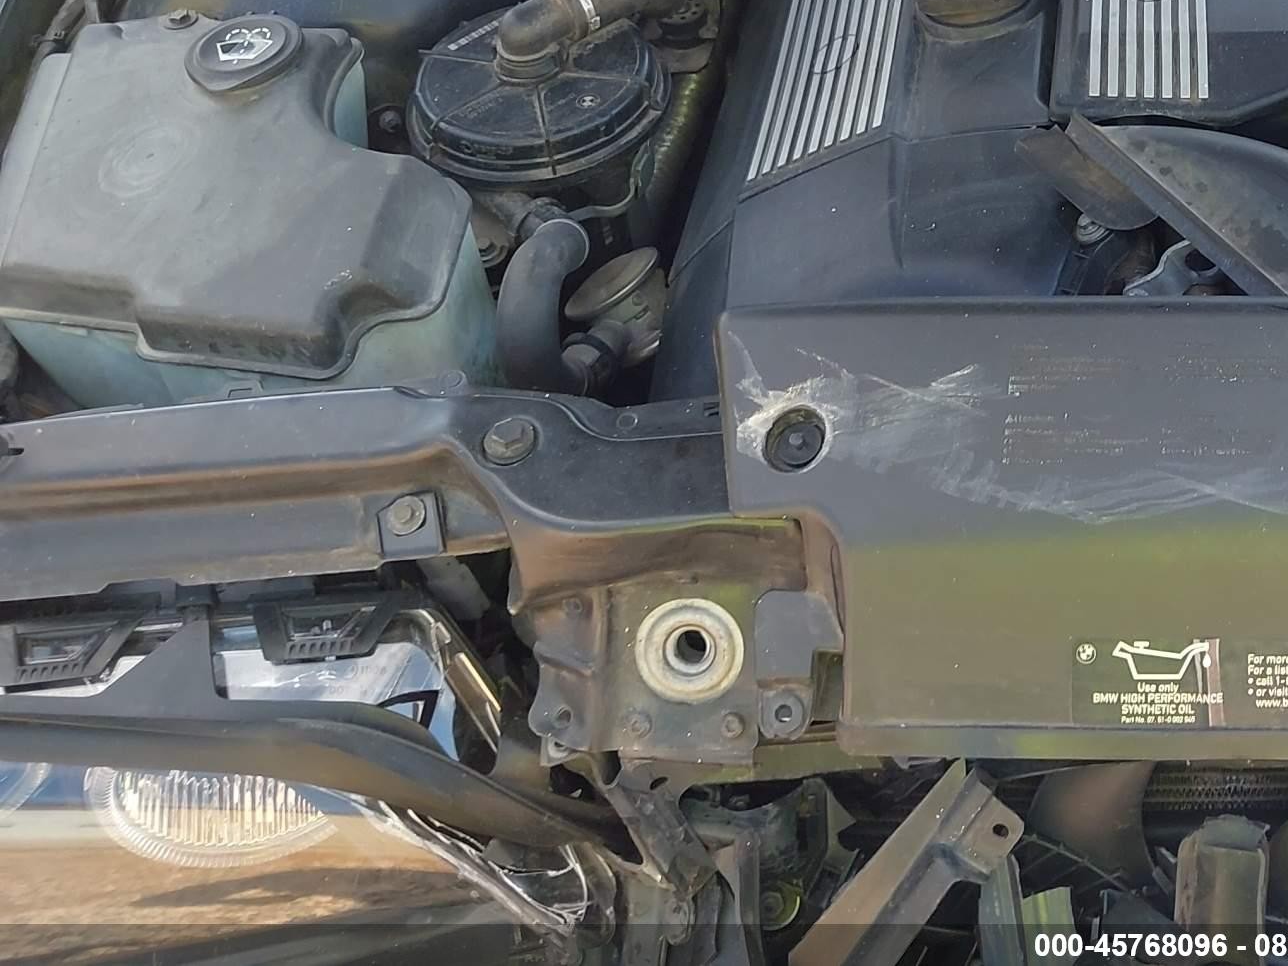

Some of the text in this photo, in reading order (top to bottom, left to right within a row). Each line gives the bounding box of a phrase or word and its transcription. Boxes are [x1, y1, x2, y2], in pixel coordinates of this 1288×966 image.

[1247, 653, 1264, 665] For
[1247, 665, 1264, 675] For
[1266, 667, 1273, 675] a
[1255, 676, 1273, 686] call
[1137, 681, 1179, 694] Use only
[1255, 688, 1267, 697] or
[1268, 687, 1288, 697] visit
[1093, 692, 1224, 704] BMW HIGH PERFORMANCE
[1121, 704, 1195, 715] SYNTHETIC OIL
[1121, 715, 1134, 724] Part
